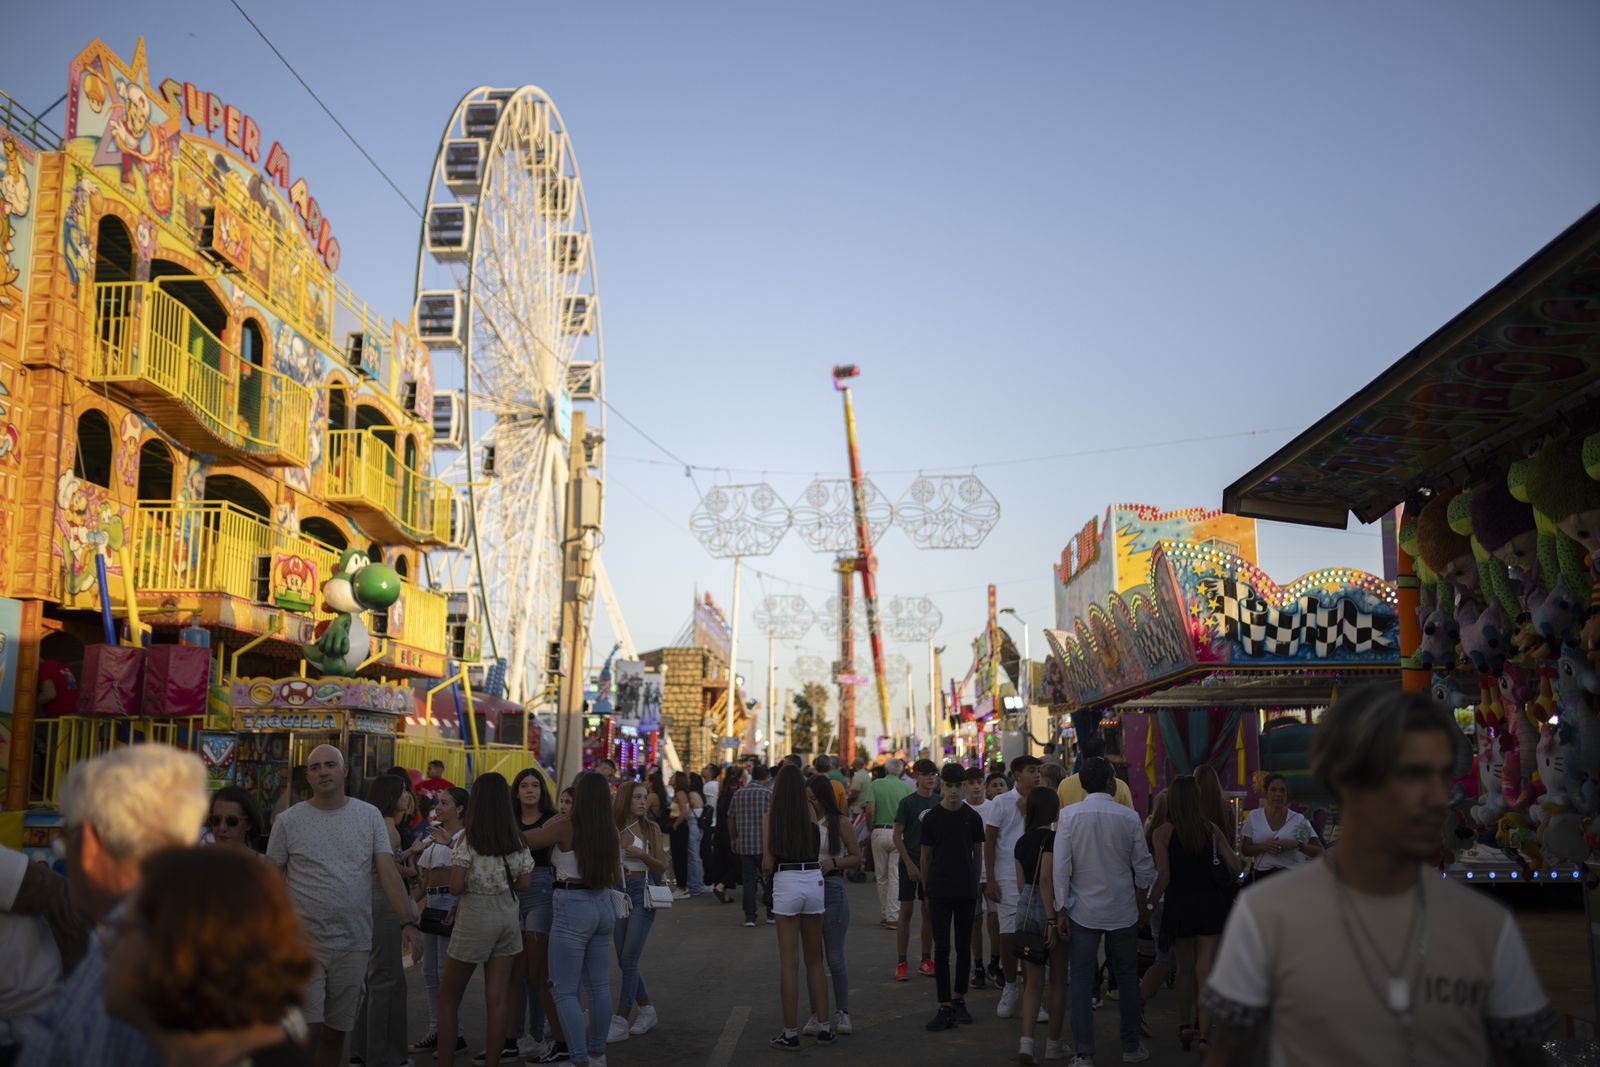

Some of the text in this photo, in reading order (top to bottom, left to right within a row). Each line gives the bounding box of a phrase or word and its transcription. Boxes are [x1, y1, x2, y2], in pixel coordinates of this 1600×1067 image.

[159, 77, 340, 272] SUPER MARIO
[242, 714, 337, 729] TAQUILLA
